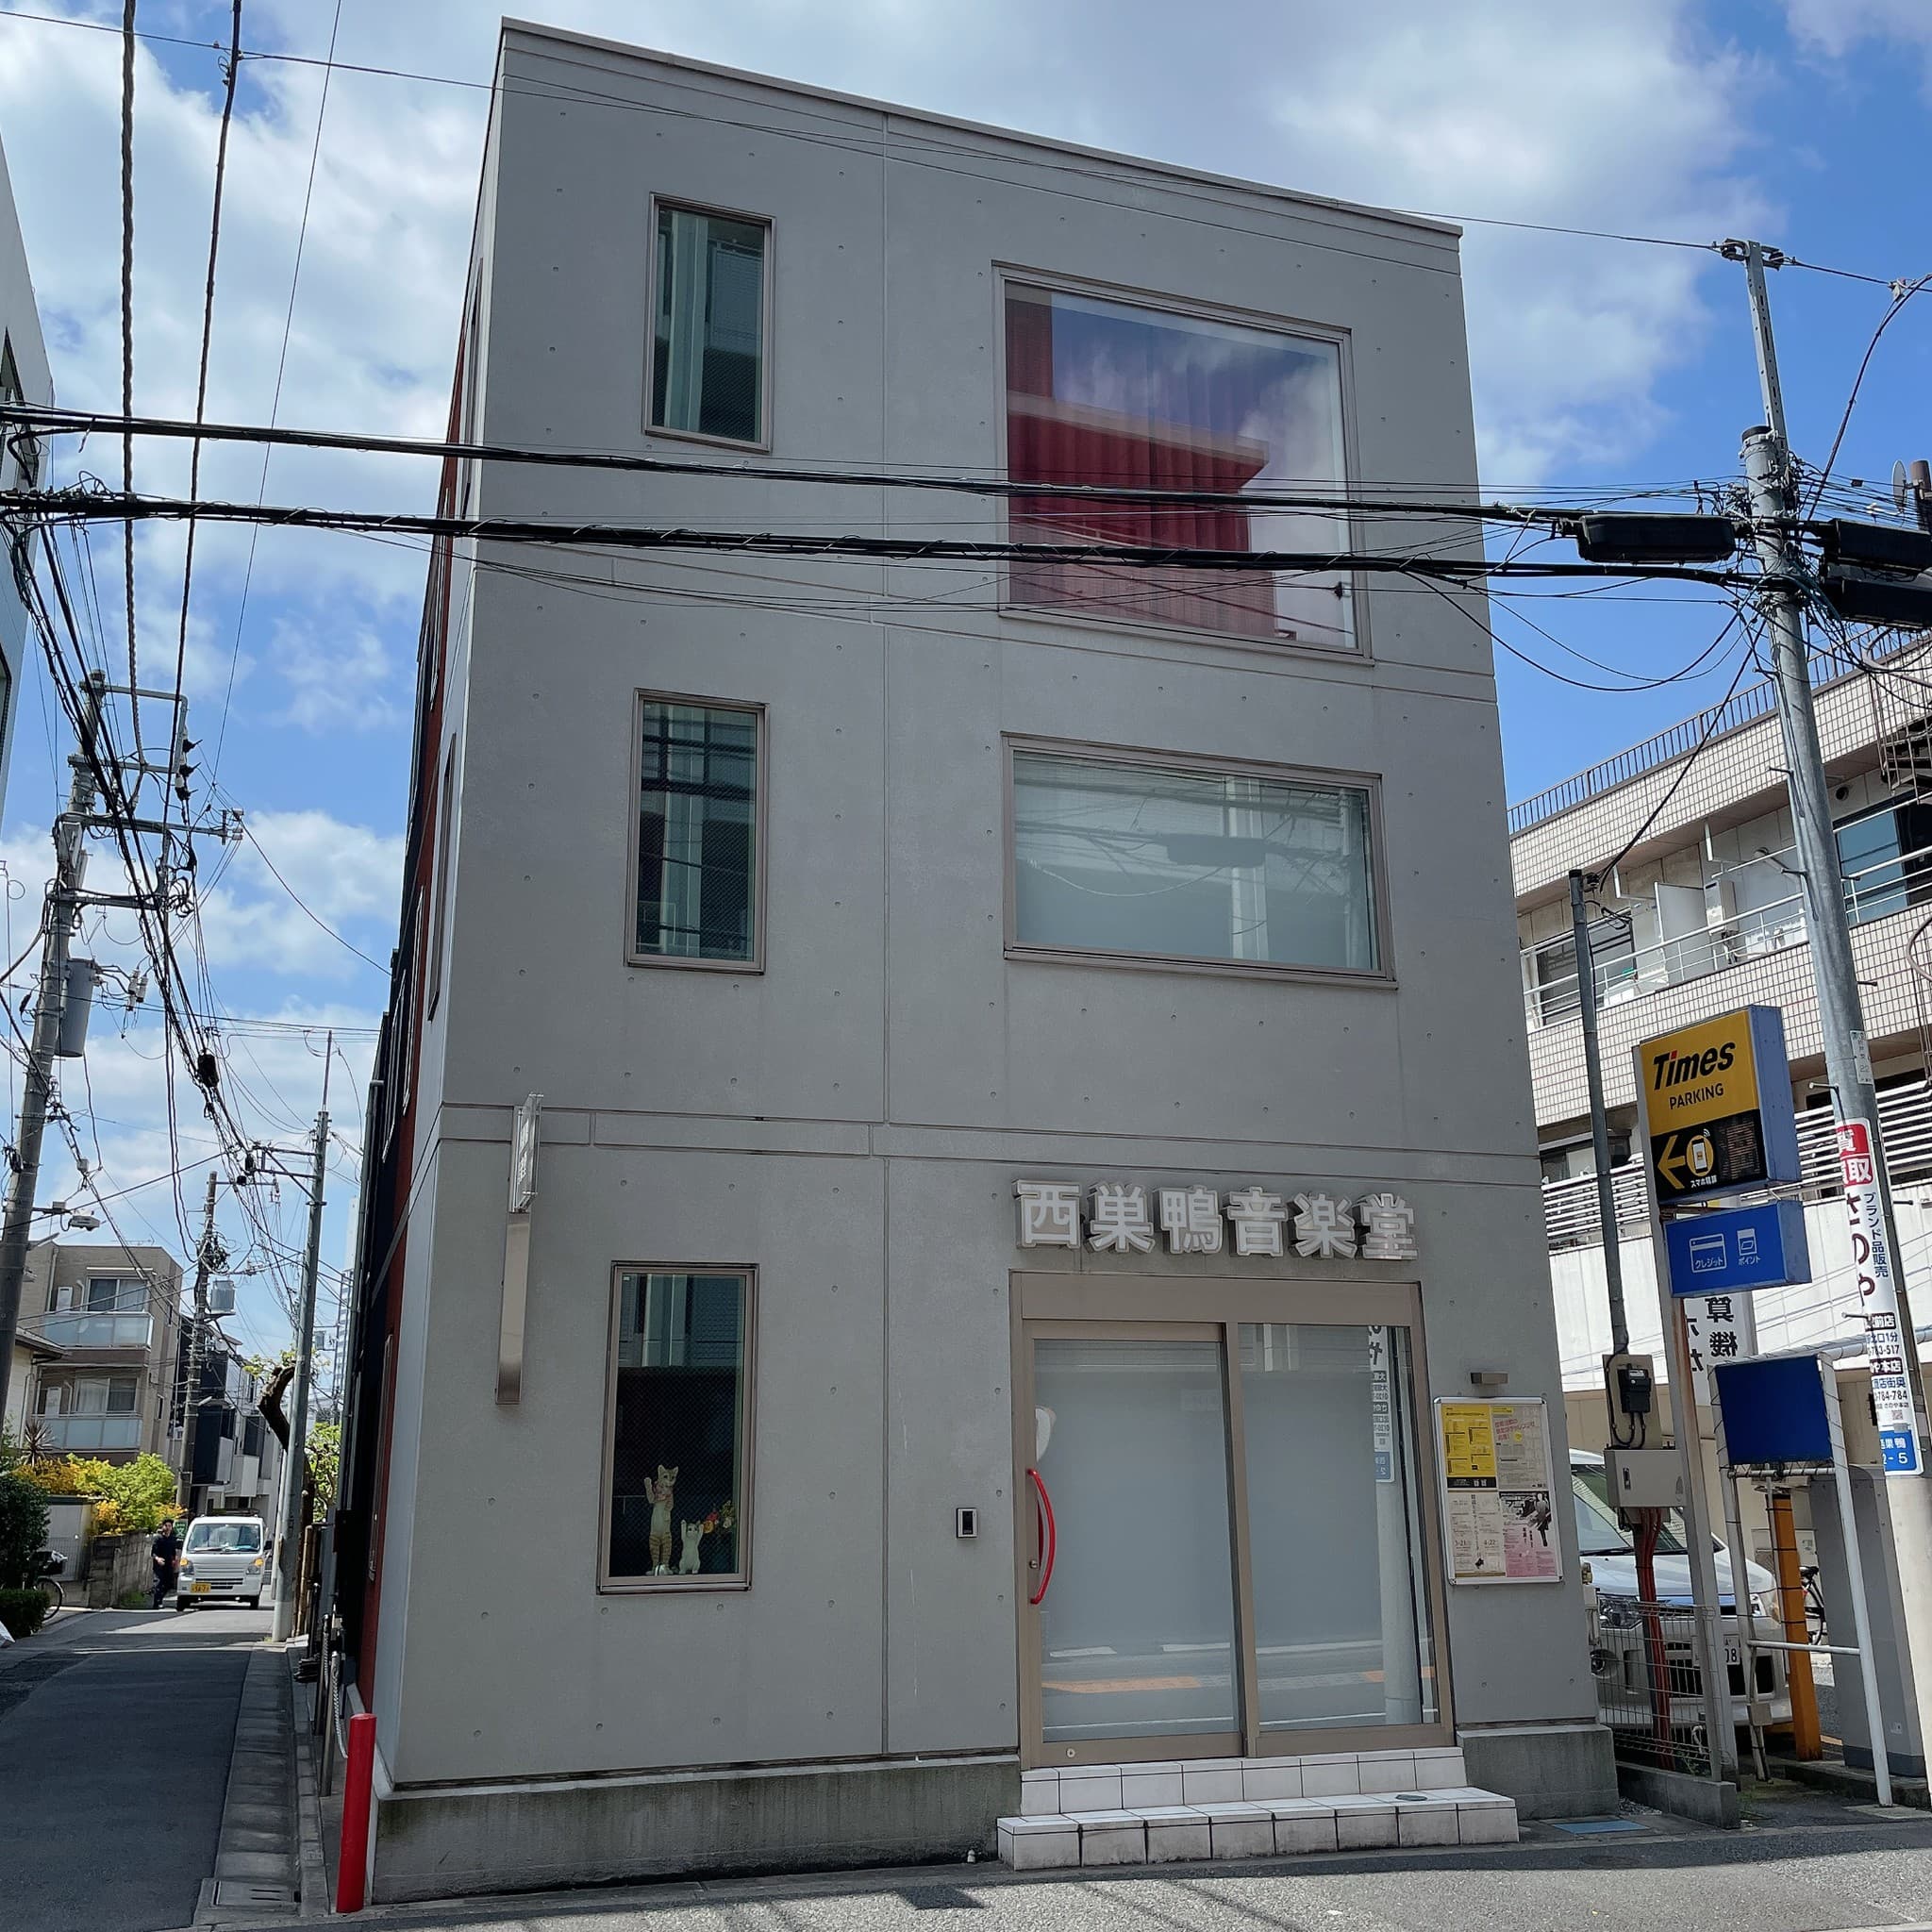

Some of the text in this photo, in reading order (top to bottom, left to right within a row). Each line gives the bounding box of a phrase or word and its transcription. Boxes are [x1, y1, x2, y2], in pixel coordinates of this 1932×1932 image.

[1653, 1041, 1736, 1091] Times
[1669, 1083, 1724, 1110] PARKING
[1013, 1178, 1420, 1260] 西巣鴨音楽堂
[1864, 1191, 1889, 1278] ブランド品販売
[1694, 1257, 1724, 1270] クレジット
[1738, 1255, 1761, 1266] ポイント
